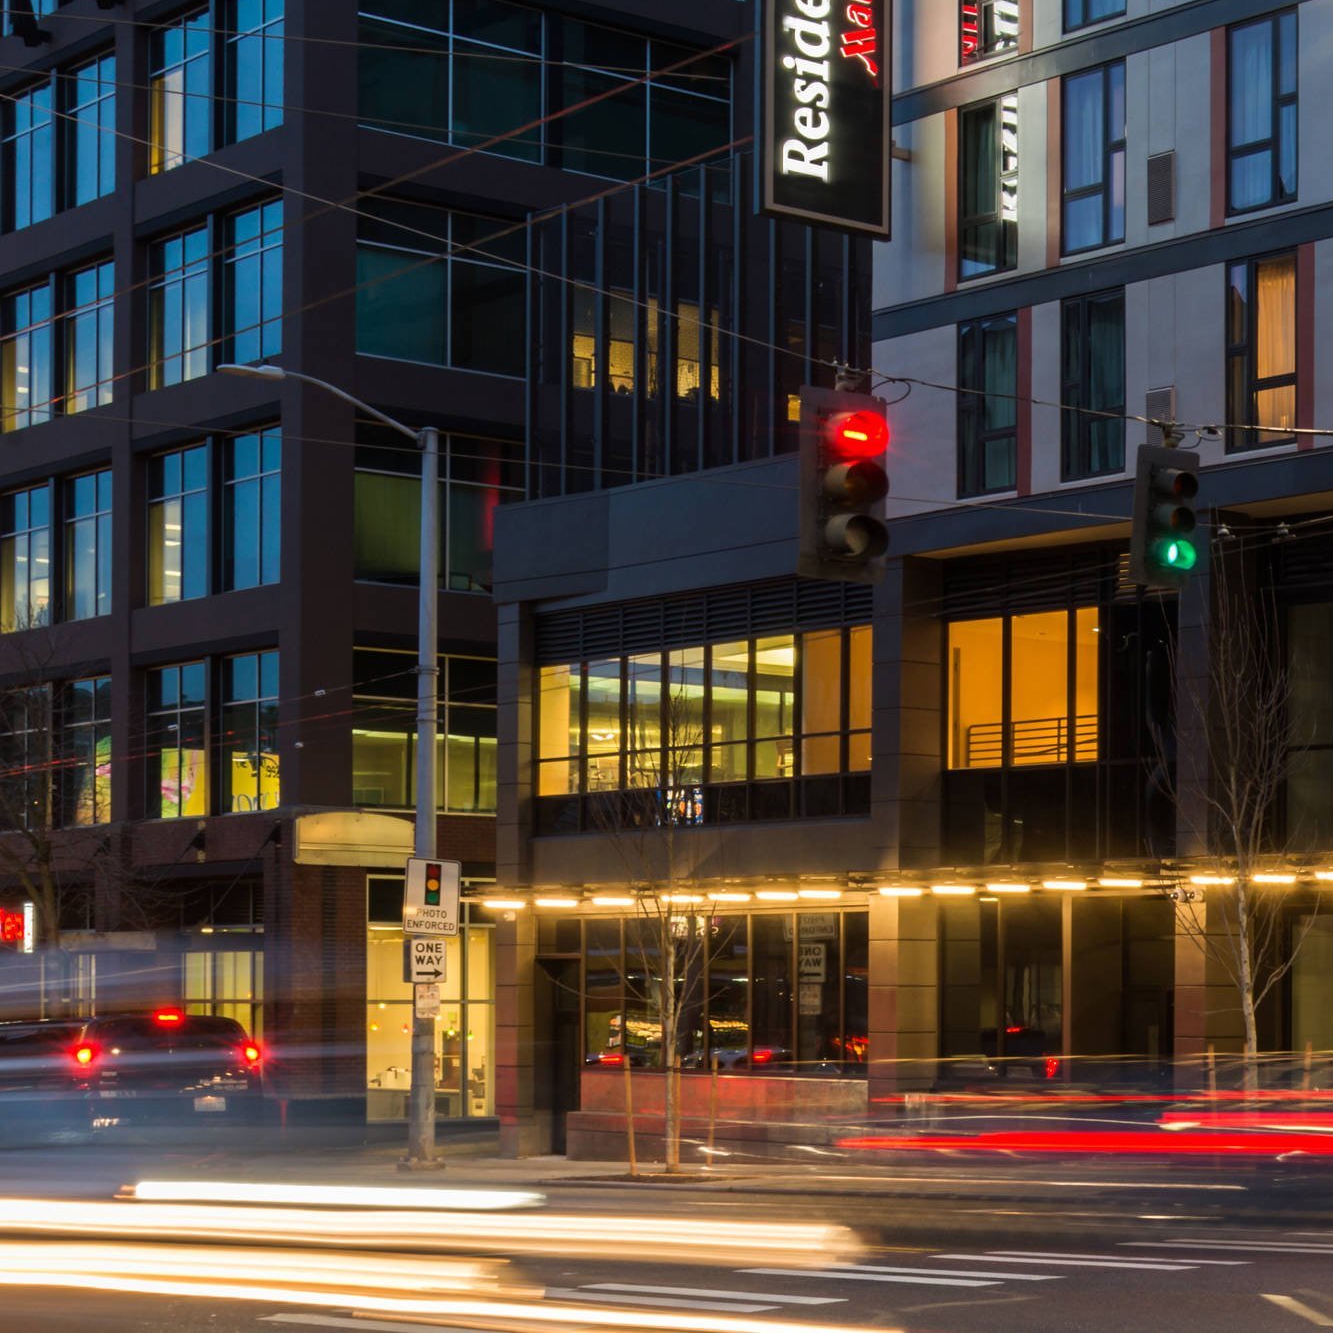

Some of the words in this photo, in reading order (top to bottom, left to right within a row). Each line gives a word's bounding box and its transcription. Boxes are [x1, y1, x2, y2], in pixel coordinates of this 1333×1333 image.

[416, 908, 448, 919] PHOTO
[407, 919, 455, 931] ENFORCED
[415, 942, 443, 953] ONE
[415, 955, 443, 966] WAY
